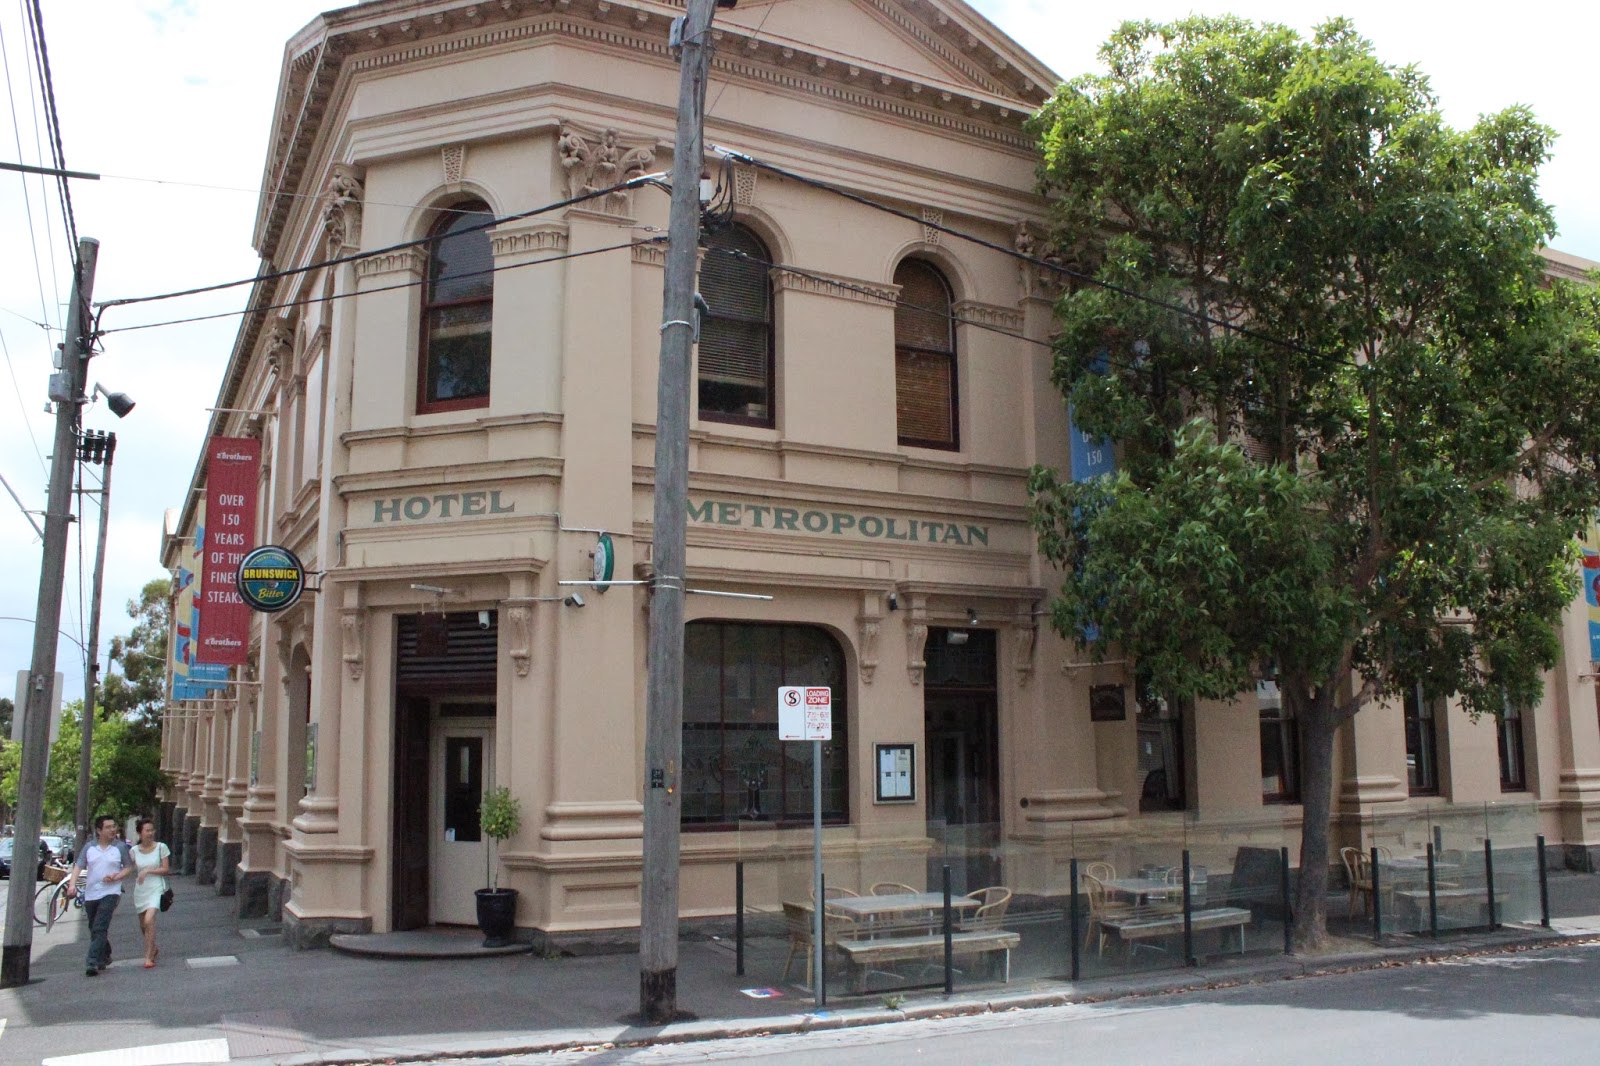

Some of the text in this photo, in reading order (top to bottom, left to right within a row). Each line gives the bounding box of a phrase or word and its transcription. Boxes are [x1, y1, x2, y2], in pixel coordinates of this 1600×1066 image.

[1087, 449, 1102, 466] 150
[219, 494, 244, 506] OVER
[373, 490, 515, 523] HOTEL
[222, 513, 240, 526] 150
[686, 499, 989, 547] METROPOLITAN
[214, 532, 245, 545] YEARS
[211, 552, 224, 564] OF
[210, 571, 236, 584] FINES
[243, 568, 298, 579] BRUNSWICK
[207, 591, 244, 603] STEAKS
[258, 588, 284, 599] Bitter
